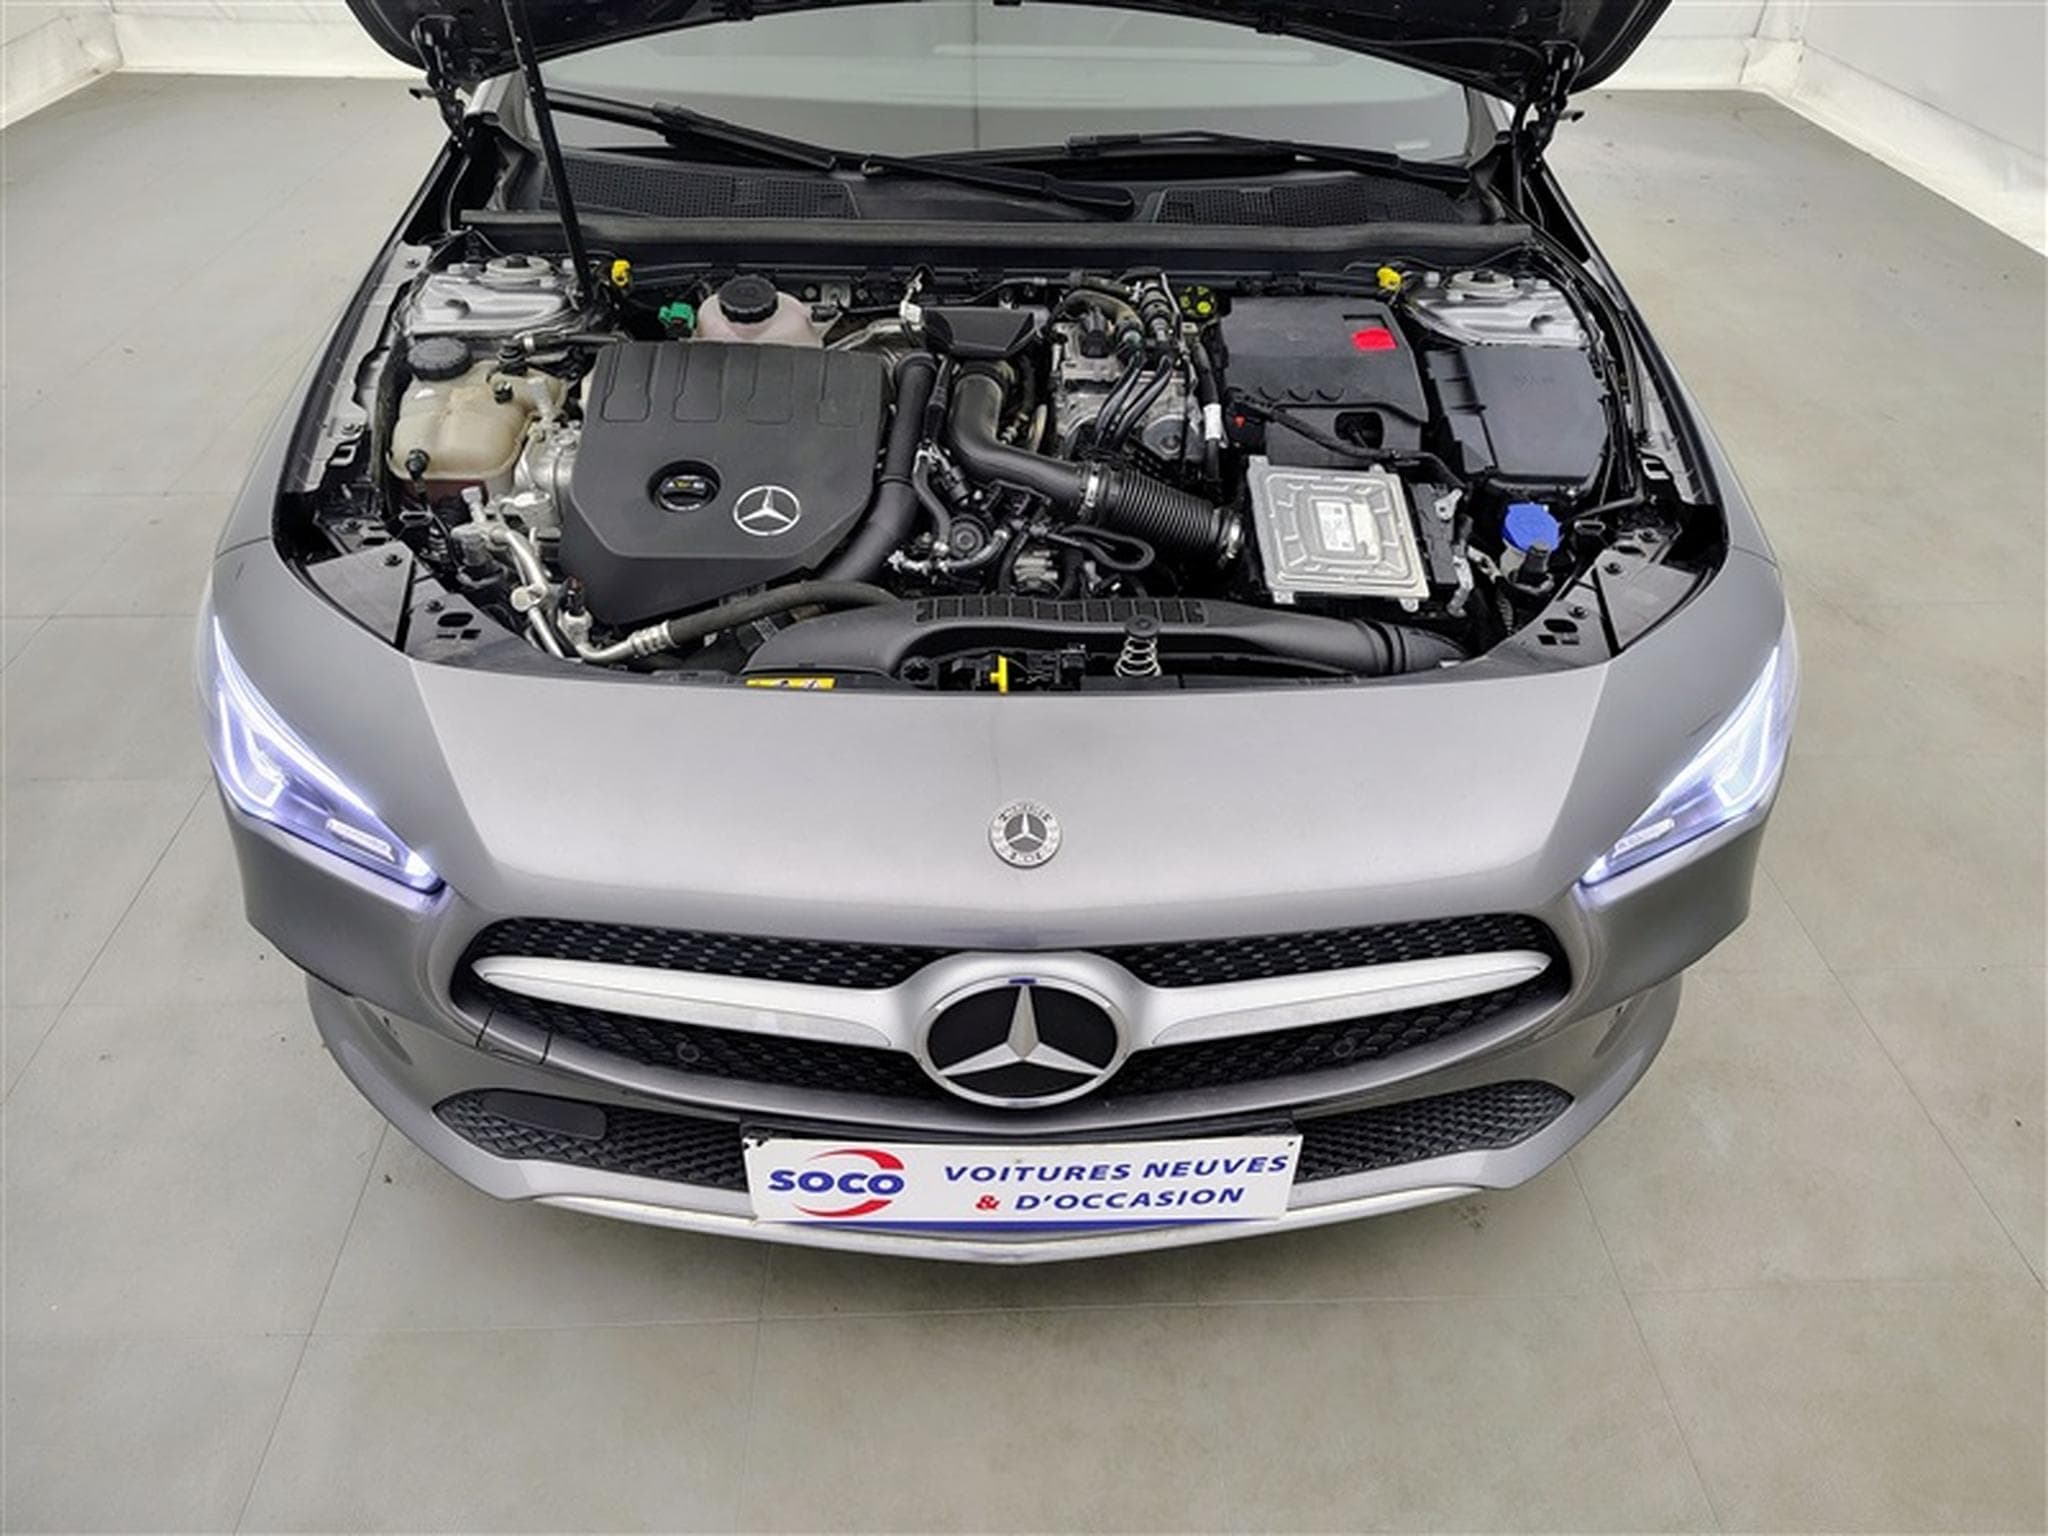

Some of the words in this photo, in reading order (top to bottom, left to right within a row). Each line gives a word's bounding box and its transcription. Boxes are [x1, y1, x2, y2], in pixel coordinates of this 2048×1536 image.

[945, 1163, 1132, 1181] VOITURES
[1143, 1156, 1289, 1178] NEUVES
[769, 1169, 905, 1195] SOCO
[975, 1195, 1000, 1210] &
[1015, 1188, 1244, 1210] D'OCCASION
